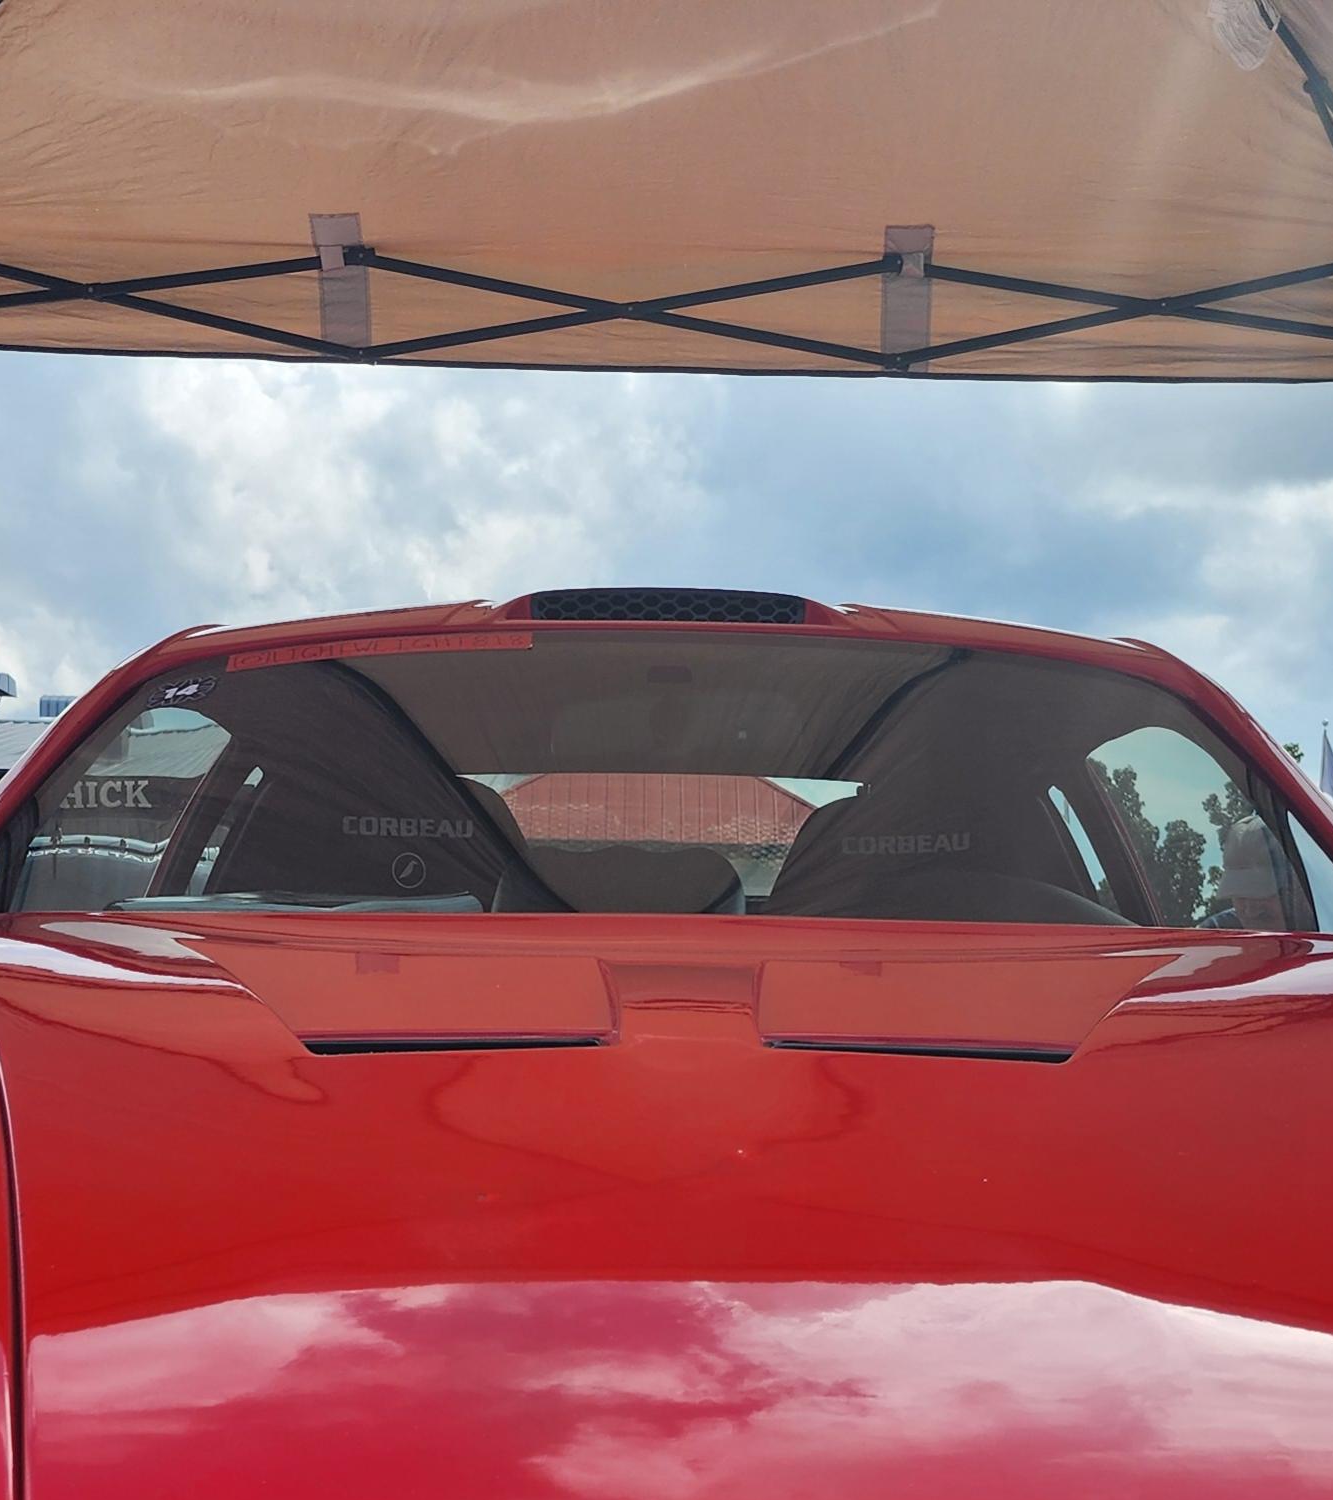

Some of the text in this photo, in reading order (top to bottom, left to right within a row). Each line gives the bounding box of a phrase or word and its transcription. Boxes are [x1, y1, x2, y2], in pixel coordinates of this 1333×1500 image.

[164, 683, 200, 700] 14
[342, 816, 474, 839] CORBEAU
[841, 832, 971, 855] CORBEAU
